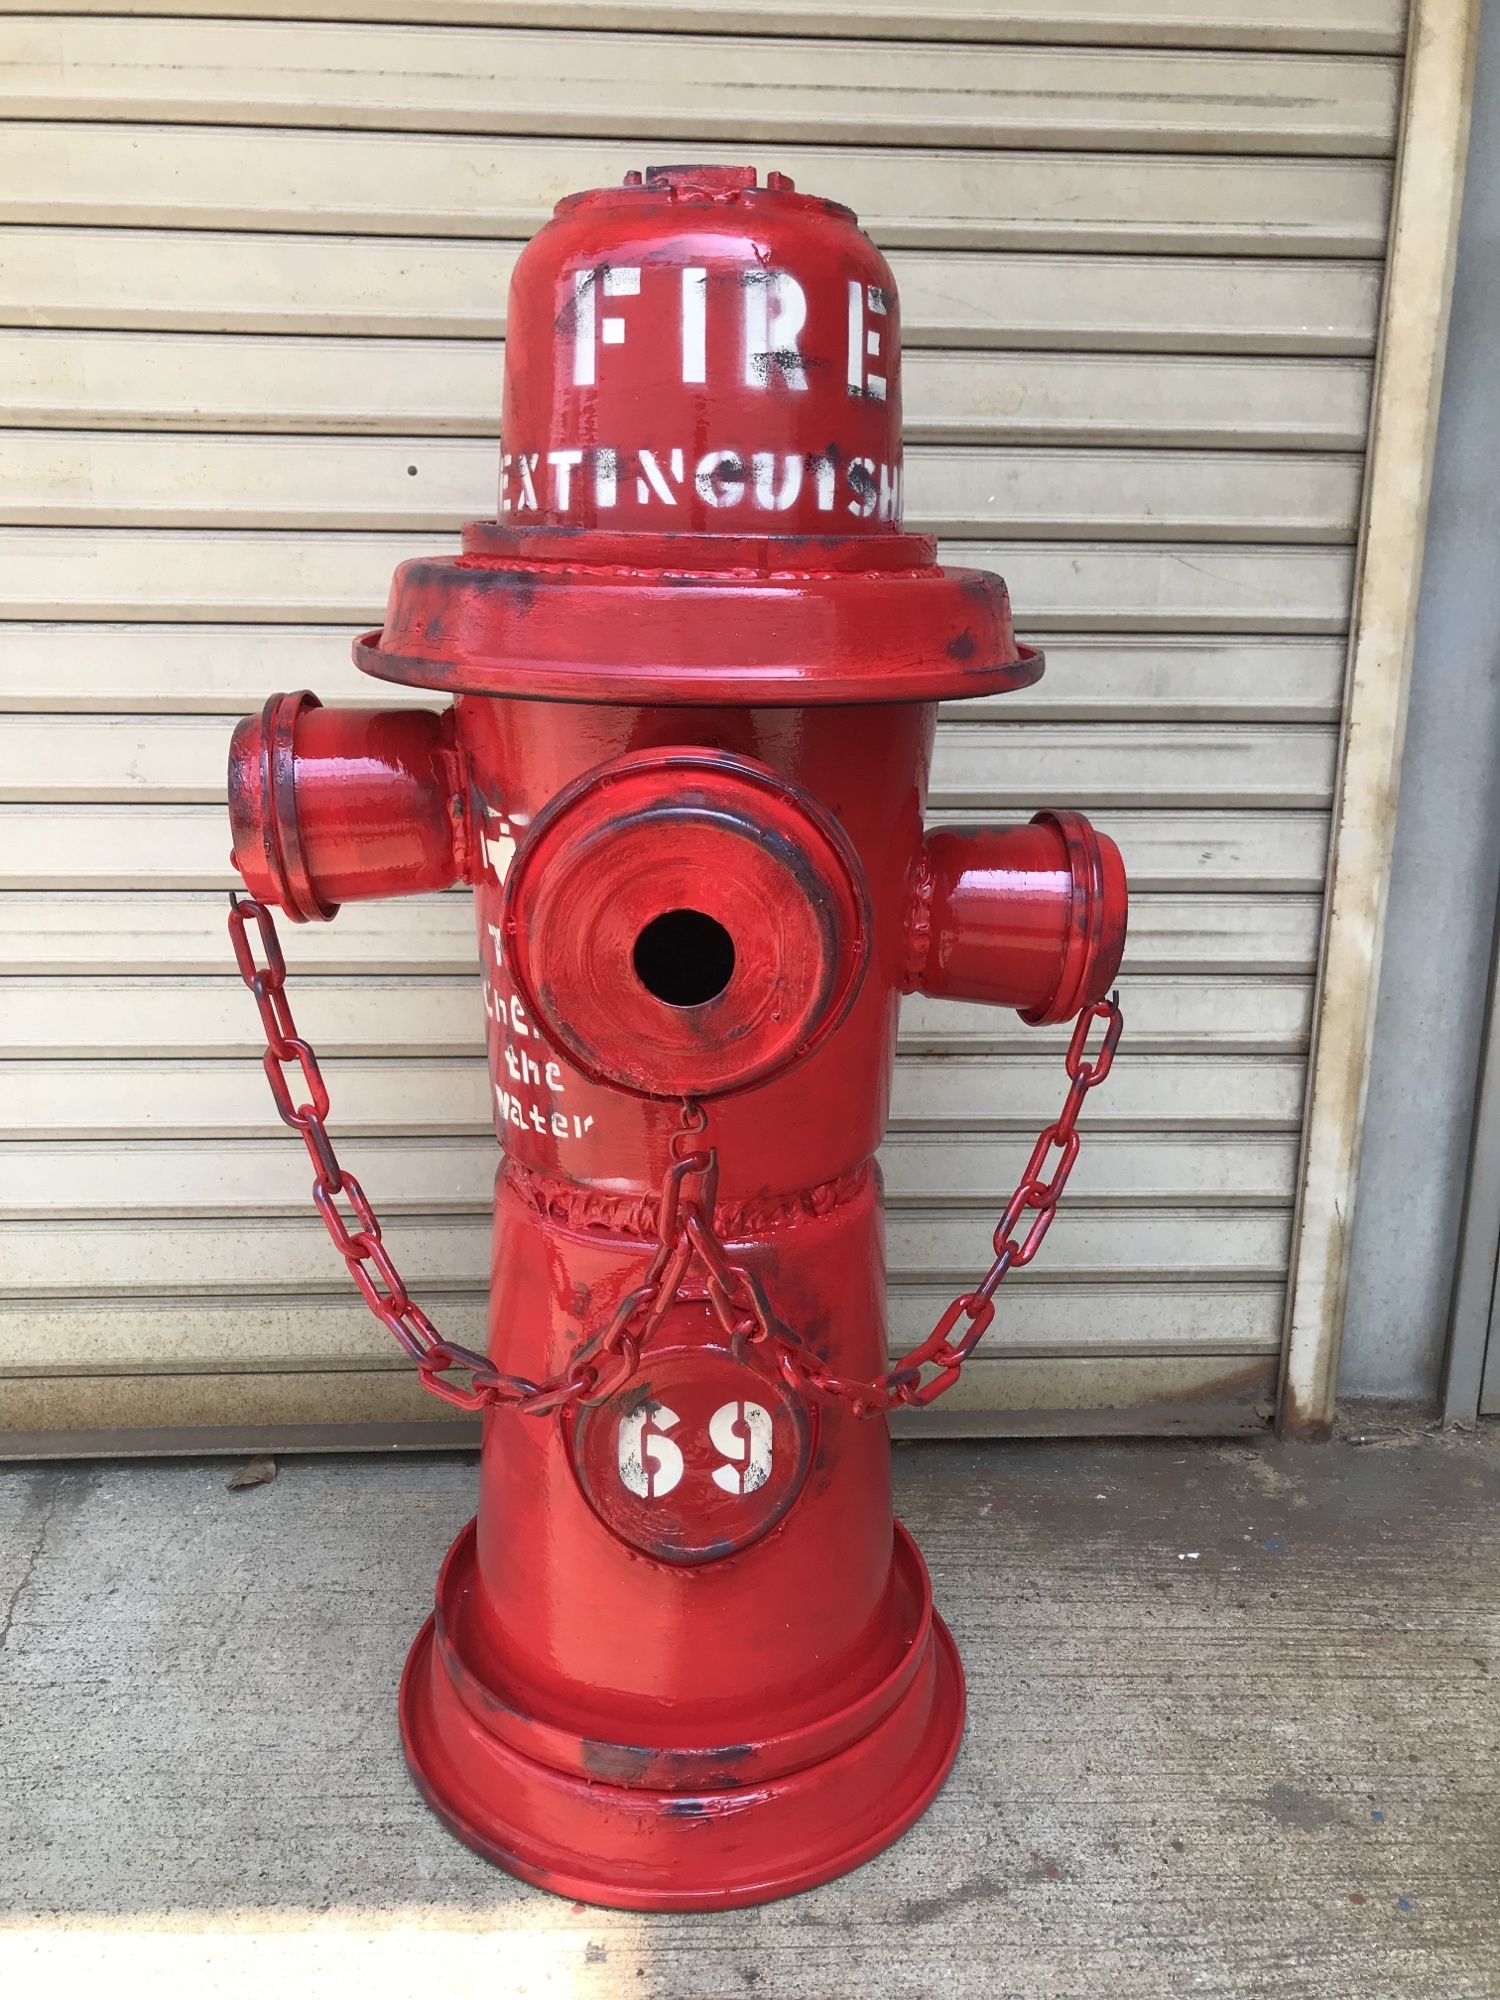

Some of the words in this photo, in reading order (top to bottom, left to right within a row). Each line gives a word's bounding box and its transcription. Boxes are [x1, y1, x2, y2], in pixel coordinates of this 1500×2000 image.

[573, 266, 888, 402] FIRE
[504, 1044, 565, 1093] the
[618, 1400, 773, 1499] 69
